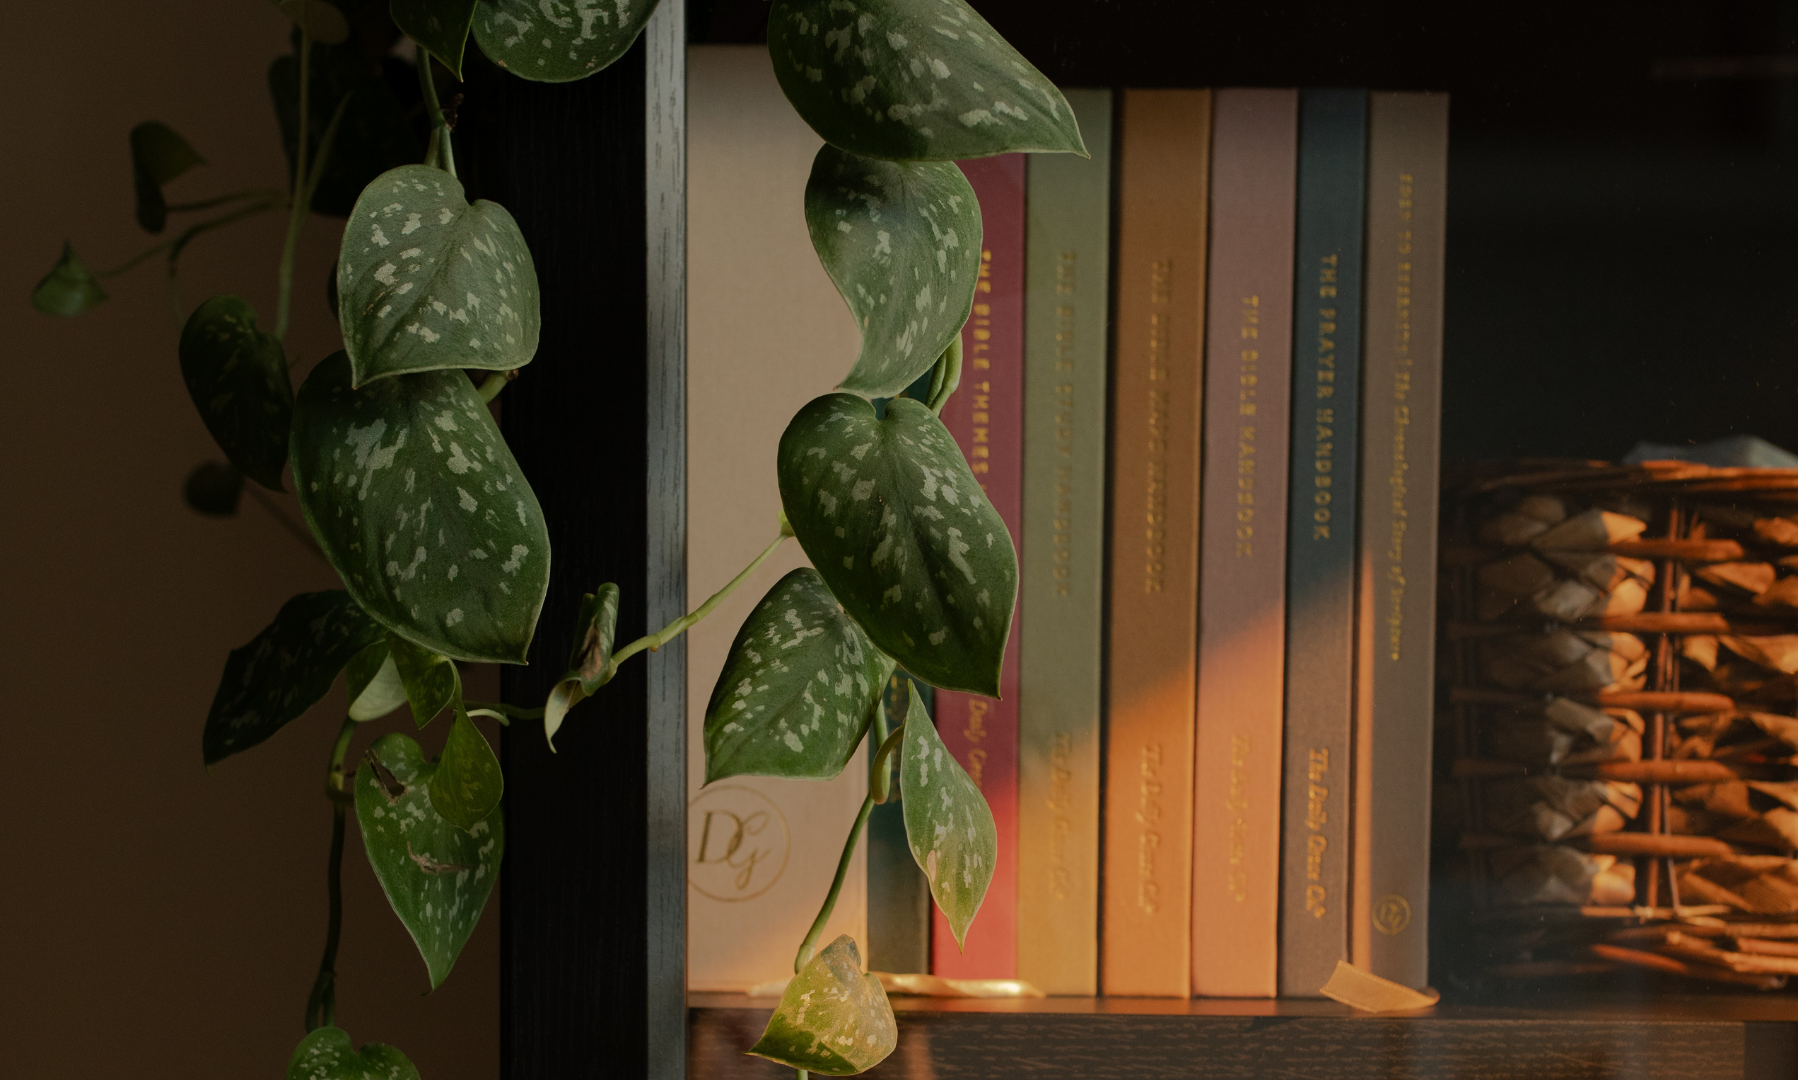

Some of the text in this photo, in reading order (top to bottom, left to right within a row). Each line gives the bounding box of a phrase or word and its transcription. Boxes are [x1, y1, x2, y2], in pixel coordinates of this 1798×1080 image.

[973, 303, 992, 371] BIBLE
[971, 380, 991, 475] THEMES
[1236, 295, 1260, 558] THE BIBLE HANDBOOK
[1313, 253, 1338, 541] THE PRAYER HANDBOOK
[1308, 747, 1330, 782] The
[1304, 783, 1329, 831] Daily
